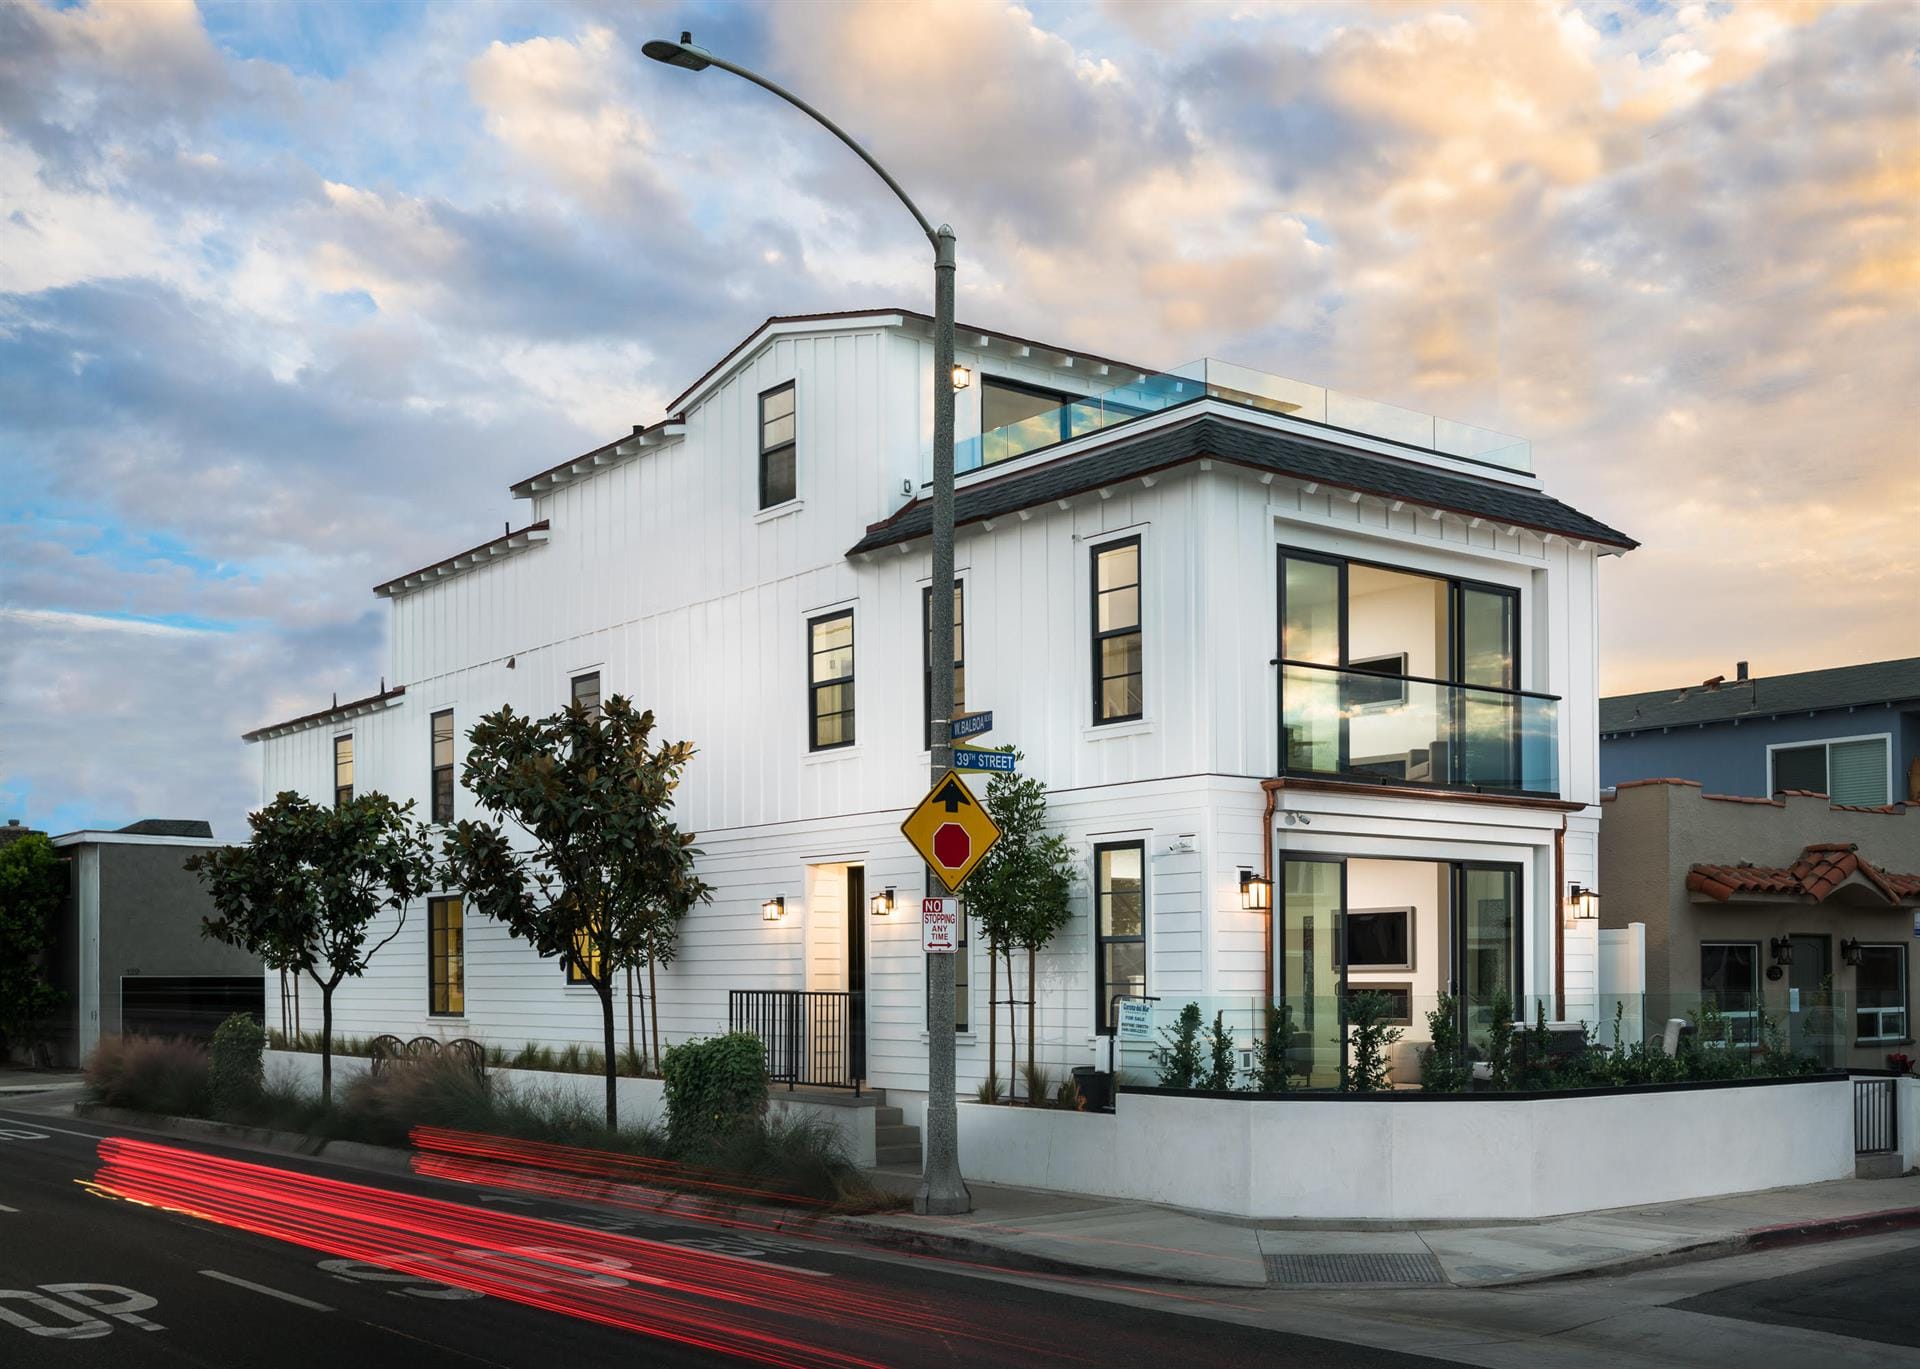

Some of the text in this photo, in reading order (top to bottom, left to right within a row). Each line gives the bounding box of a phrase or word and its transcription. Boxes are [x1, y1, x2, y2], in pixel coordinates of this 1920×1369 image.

[956, 752, 1013, 769] 39TH STREET
[925, 900, 941, 912] NO
[924, 913, 955, 924] STOPPING
